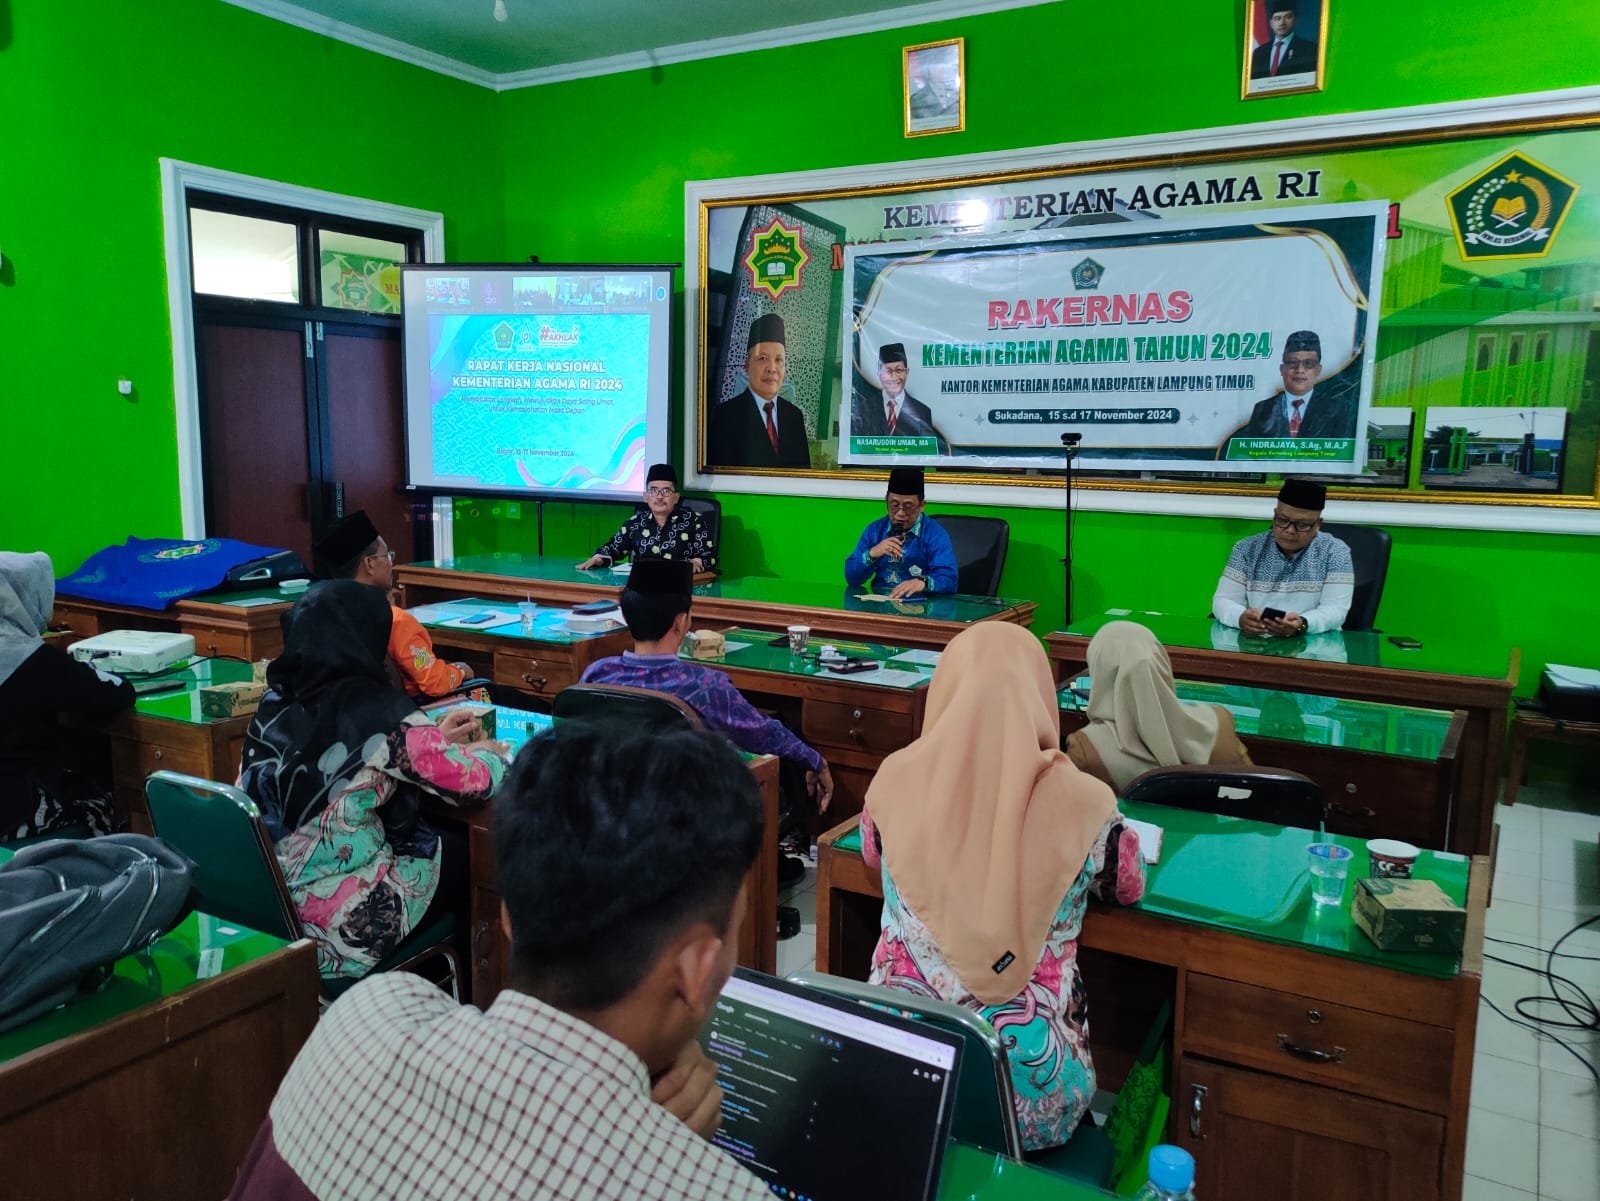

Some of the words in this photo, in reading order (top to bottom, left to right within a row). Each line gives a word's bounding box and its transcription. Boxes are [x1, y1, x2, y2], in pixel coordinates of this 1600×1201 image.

[884, 188, 1117, 230] KEMTERIAN
[1128, 175, 1263, 210] AGAMA
[1276, 171, 1321, 199] RI
[986, 290, 1194, 330] RAKERNAS
[922, 339, 1052, 368] KEMENTERIAN
[1054, 335, 1132, 365] AGAMA
[1134, 333, 1208, 362] TAHUN
[1210, 331, 1274, 360] 2024
[468, 360, 505, 371] RAPAT
[507, 360, 544, 372] KERJA
[546, 361, 606, 373] NASIONAL
[452, 376, 531, 389] KEMENTERIAN
[534, 378, 577, 390] AGAMA
[579, 378, 592, 390] RI
[594, 379, 623, 391] 2024
[941, 379, 979, 393] KANTOR
[981, 378, 1050, 393] KEMENTERIAN
[1051, 377, 1090, 392] AGAMA
[1091, 376, 1155, 392] KABUPATEN
[1156, 375, 1213, 391] LAMPUNG
[1215, 374, 1256, 390] TIMUR
[994, 410, 1043, 422] Sukadana,
[1048, 411, 1060, 420] 15
[1062, 410, 1077, 420] s.d
[1079, 410, 1091, 420] 17
[1094, 410, 1145, 420] November
[1146, 410, 1173, 420] 2024
[1250, 441, 1298, 450] INDRAJAYA,
